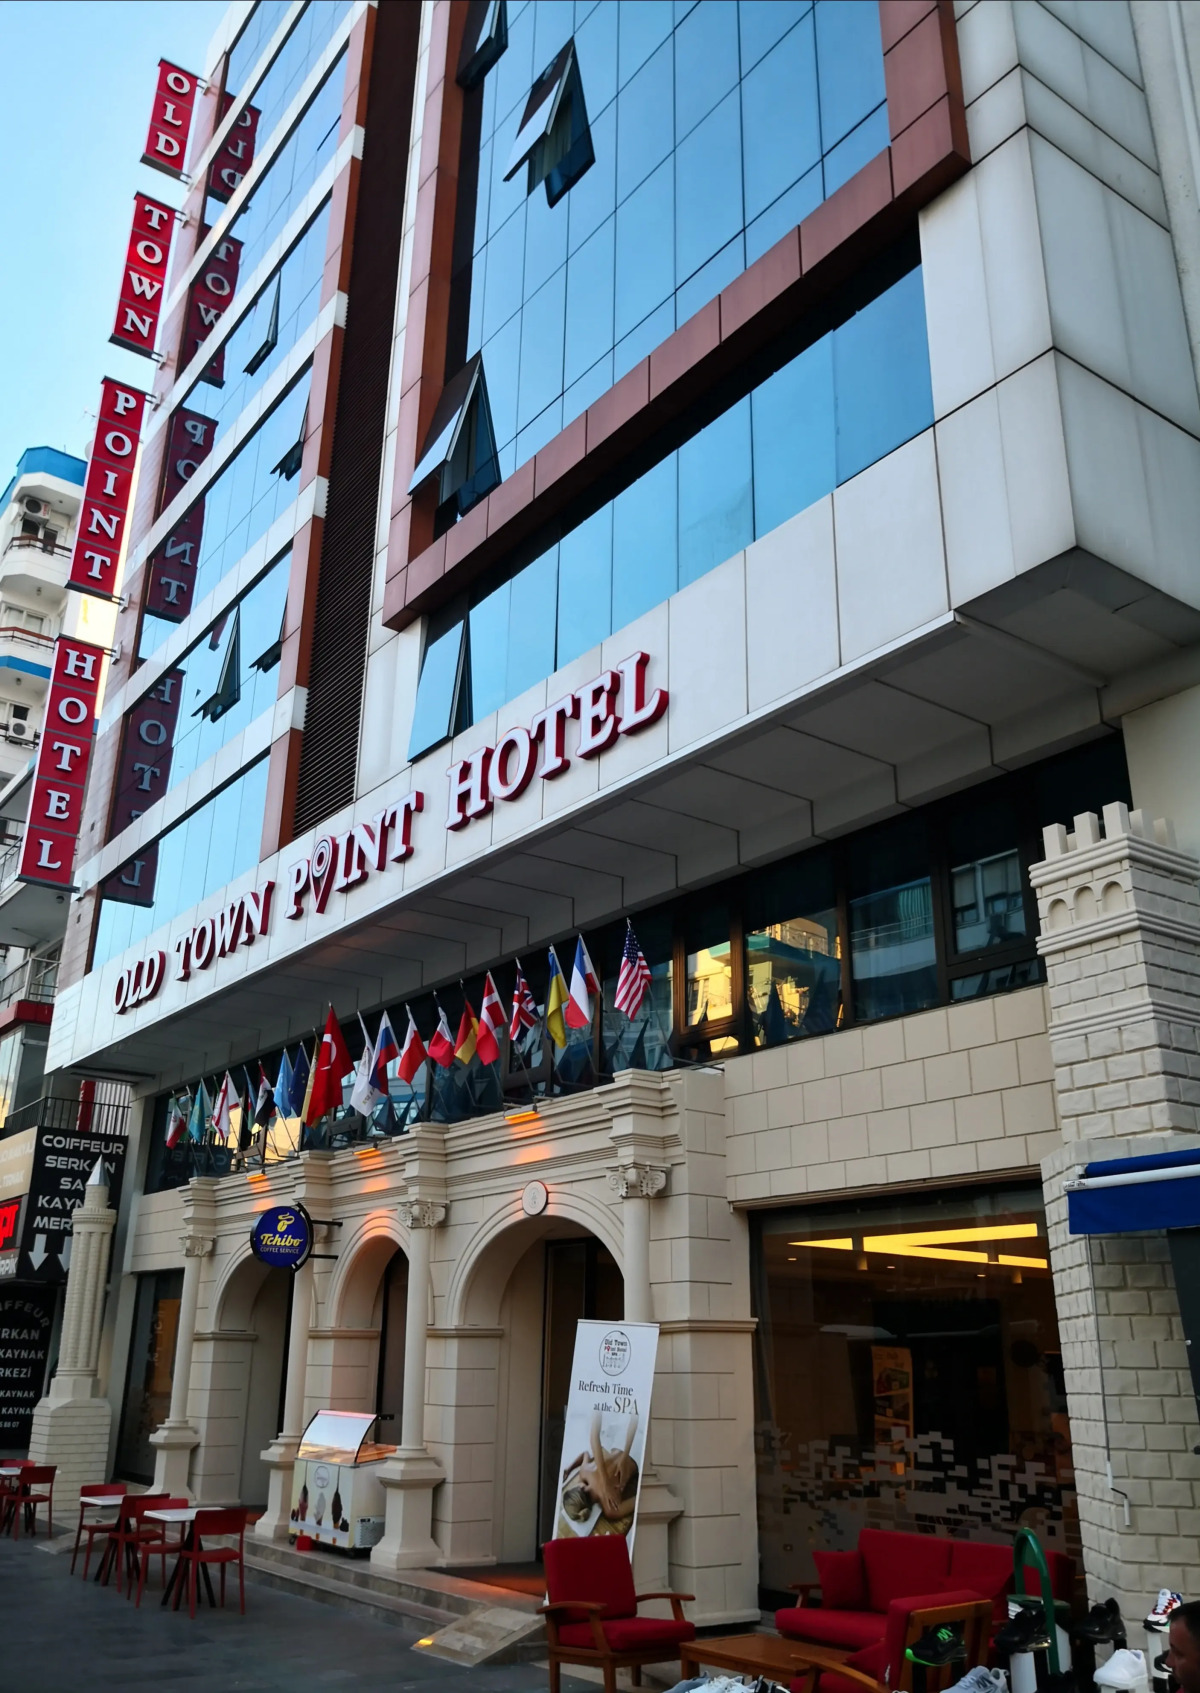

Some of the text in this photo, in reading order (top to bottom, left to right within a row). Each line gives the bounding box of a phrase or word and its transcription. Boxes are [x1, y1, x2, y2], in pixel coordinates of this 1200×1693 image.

[36, 72, 191, 869] OLD TOWN POINT HOTEL
[111, 650, 670, 1015] OLD TOWN POINT HOTEL
[42, 1135, 125, 1155] COIFFEUR
[59, 1177, 84, 1191] SA
[260, 1233, 303, 1247] Tchibo
[0, 1328, 40, 1340] RKAN
[578, 1380, 634, 1397] Refresh Time
[593, 1396, 639, 1416] at the SPA
